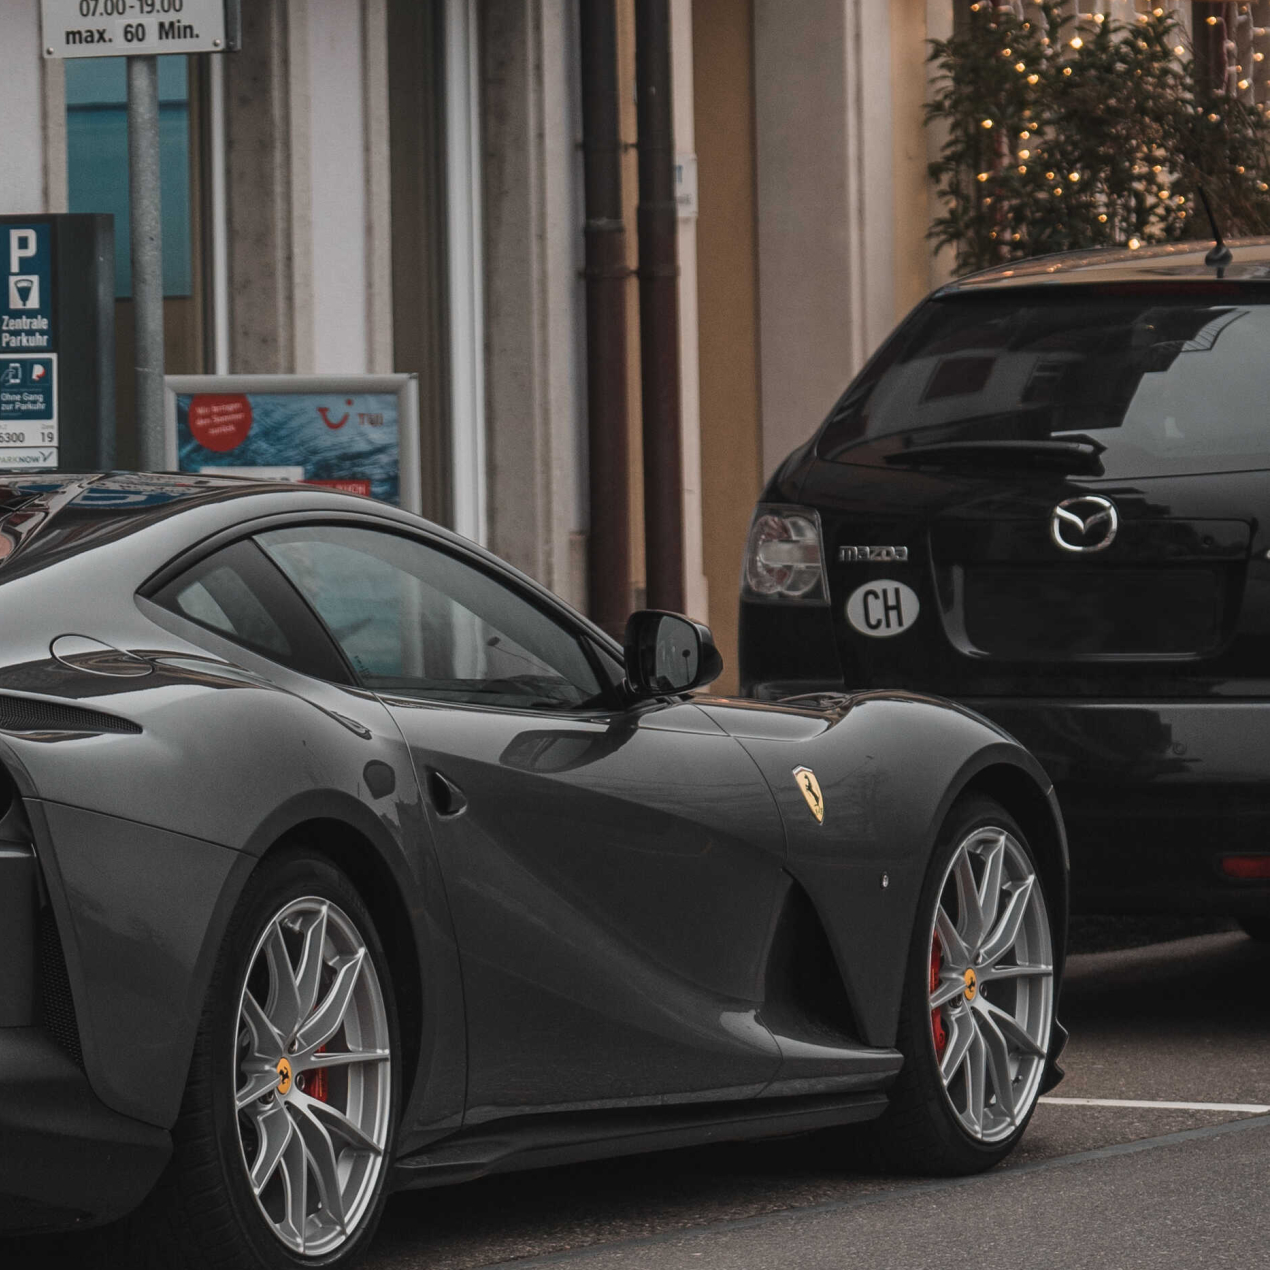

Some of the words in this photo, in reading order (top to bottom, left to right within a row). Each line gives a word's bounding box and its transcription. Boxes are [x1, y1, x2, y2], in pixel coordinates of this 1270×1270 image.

[65, 28, 113, 45] max.
[123, 23, 146, 43] 60
[158, 19, 200, 41] Min.
[9, 228, 37, 273] P
[1, 315, 49, 330] Zentrale
[1, 332, 49, 348] Parkuhr
[40, 432, 54, 443] 19
[863, 586, 904, 630] CH
